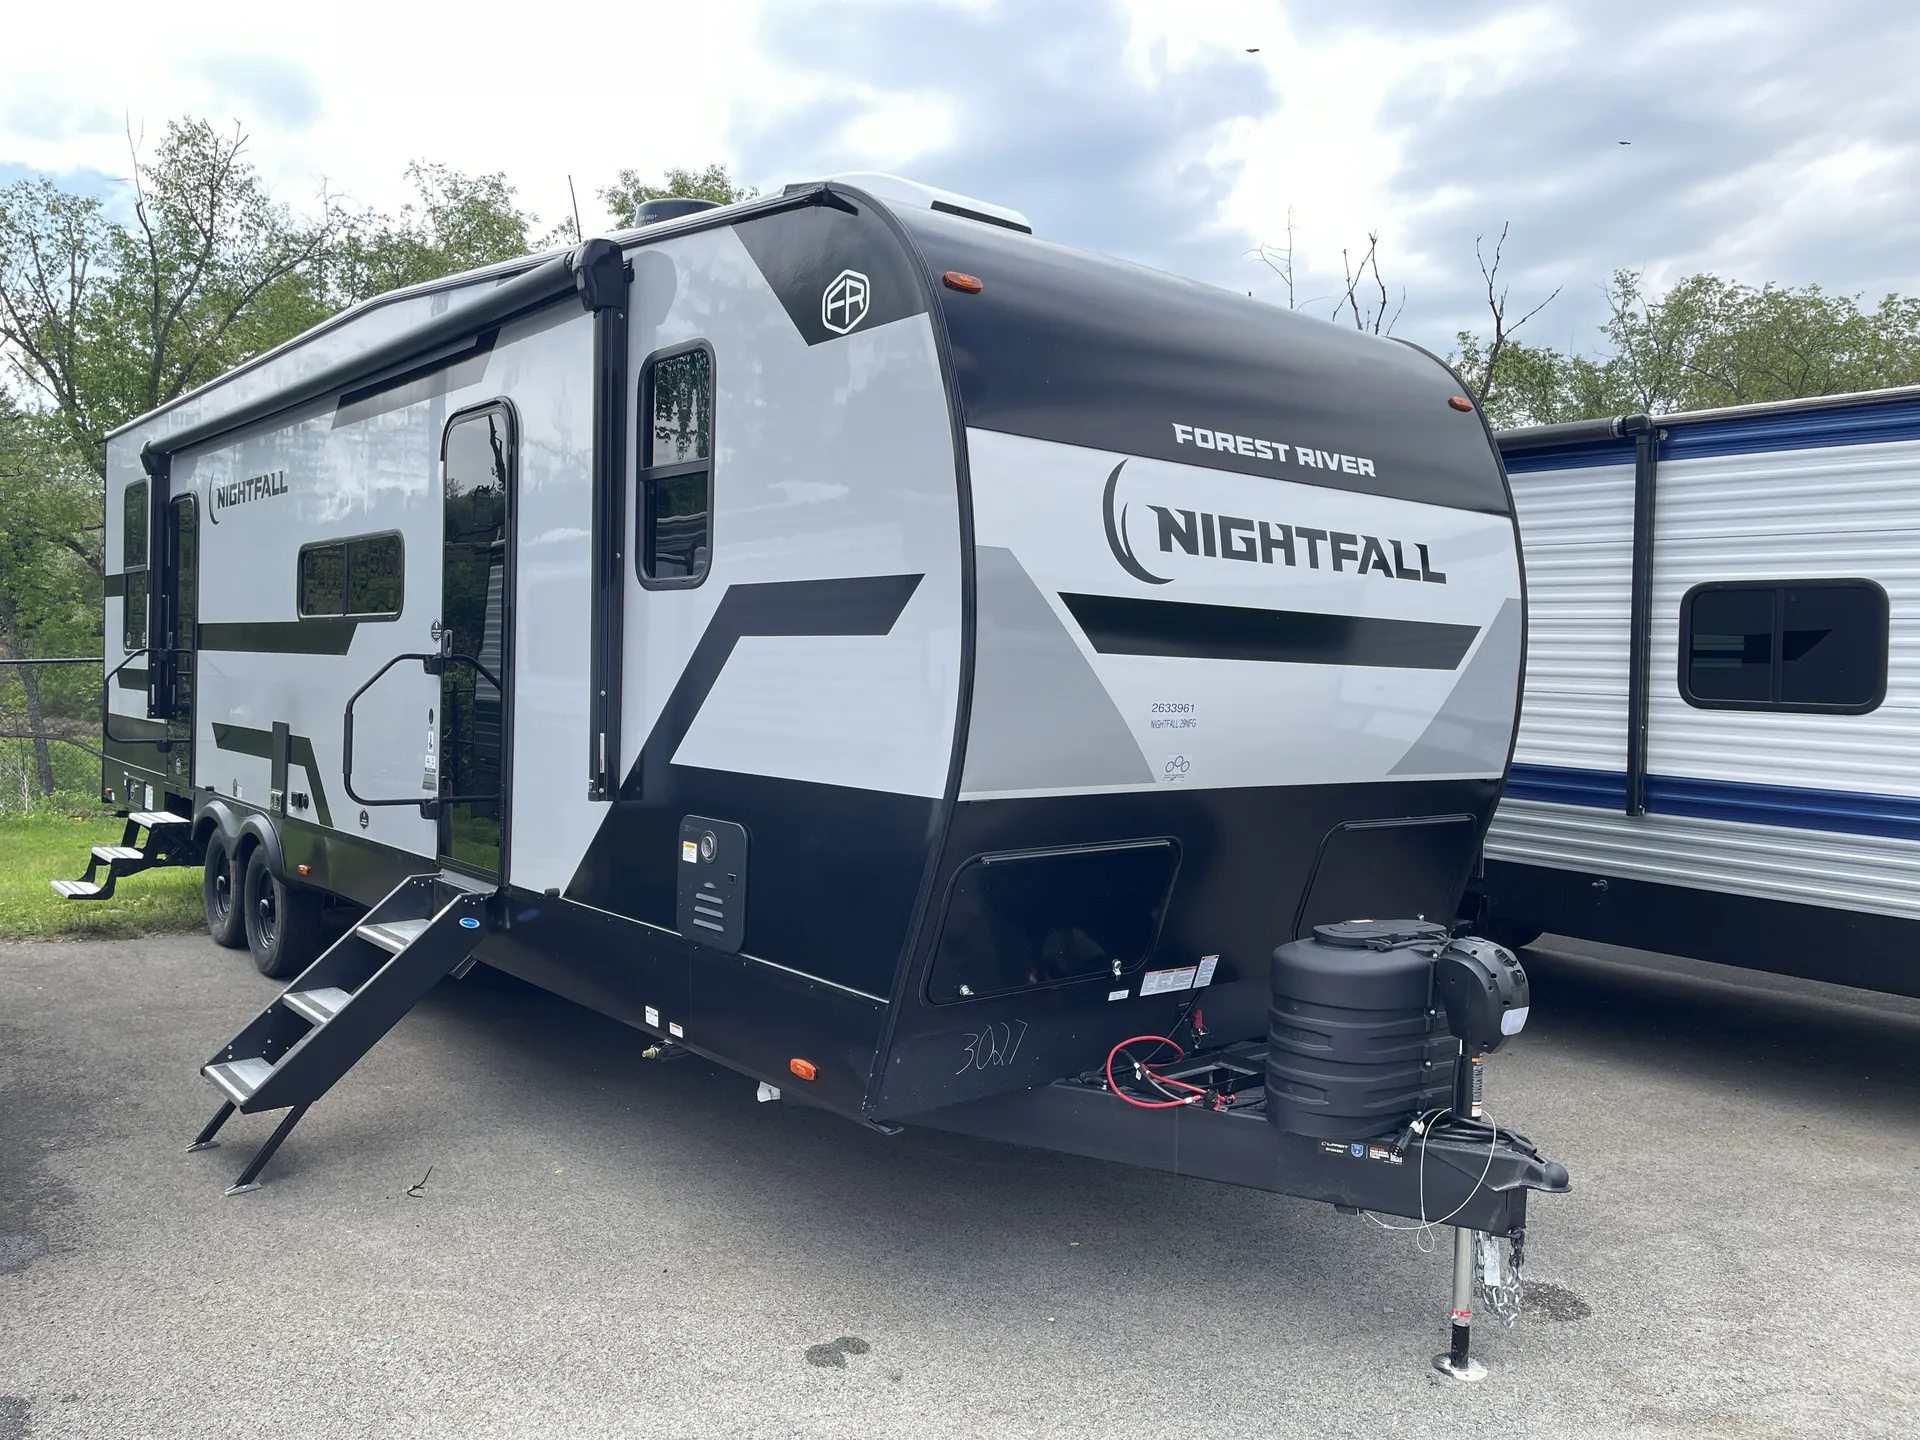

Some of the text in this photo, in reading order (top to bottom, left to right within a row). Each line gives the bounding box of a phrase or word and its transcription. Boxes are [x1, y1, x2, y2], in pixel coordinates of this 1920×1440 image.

[1172, 423, 1377, 477] FOREST RIVER
[216, 470, 288, 509] NIGHTFALL
[1145, 504, 1447, 584] NIGHTFALL
[1151, 703, 1195, 713] 2633961
